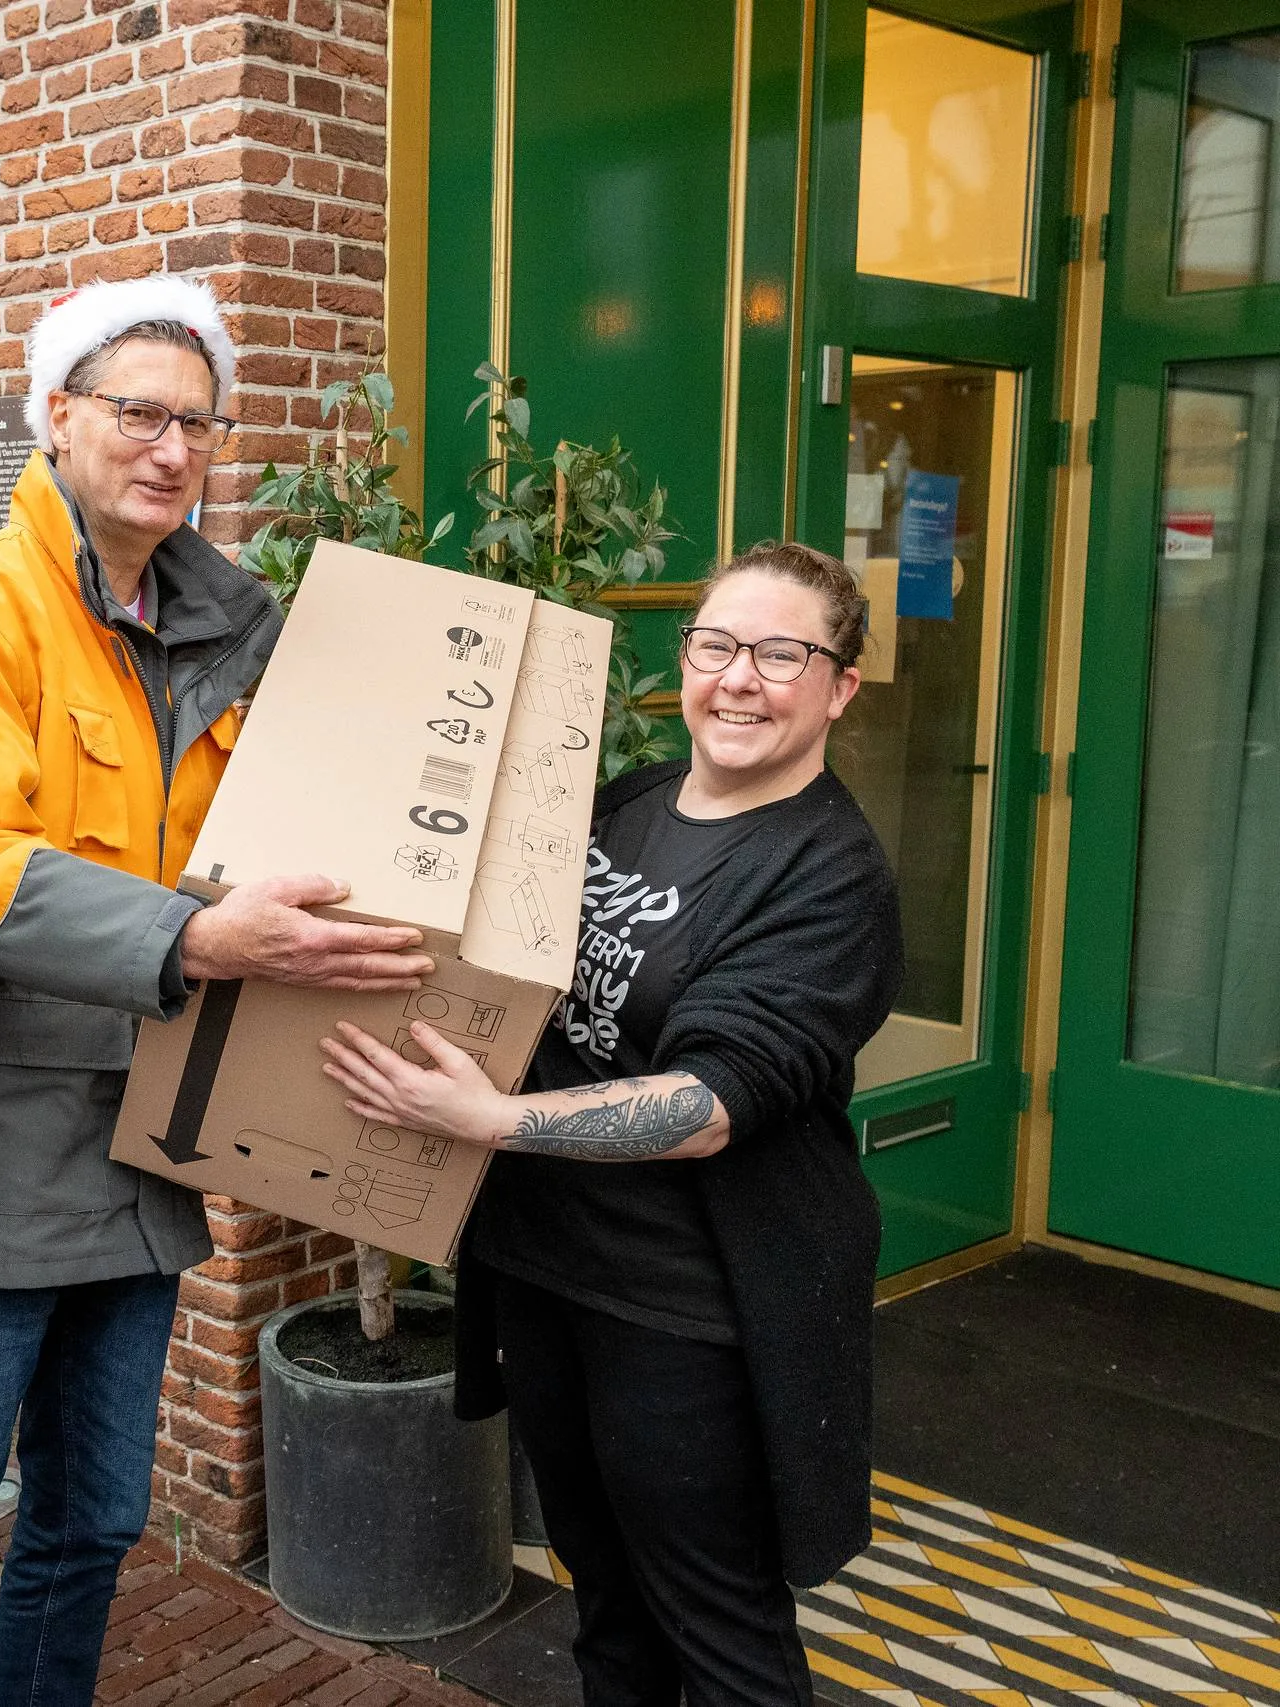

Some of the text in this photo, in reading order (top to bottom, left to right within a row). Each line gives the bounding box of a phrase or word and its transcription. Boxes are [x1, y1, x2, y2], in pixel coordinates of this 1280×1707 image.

[456, 628, 471, 661] PACK POINT
[447, 724, 460, 736] 20
[473, 728, 487, 745] PAP
[408, 805, 469, 835] 6
[417, 849, 436, 876] RESY
[578, 923, 645, 977] TERM
